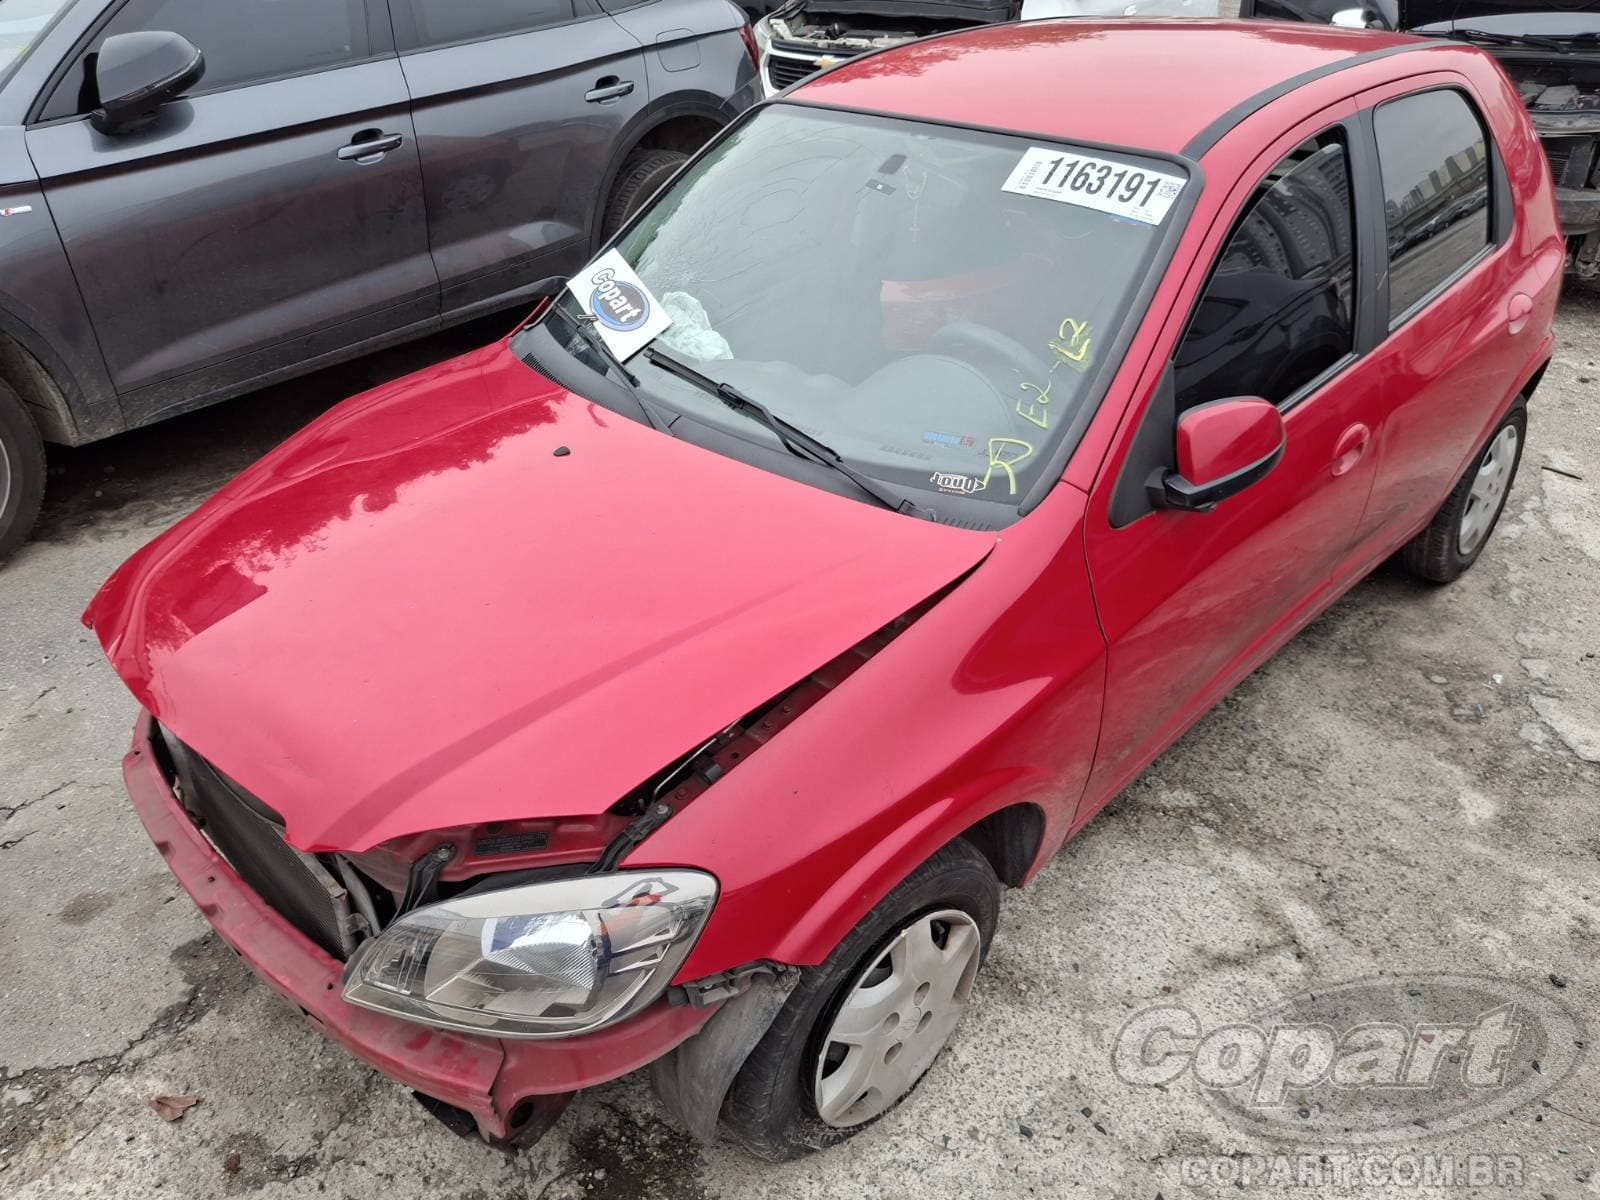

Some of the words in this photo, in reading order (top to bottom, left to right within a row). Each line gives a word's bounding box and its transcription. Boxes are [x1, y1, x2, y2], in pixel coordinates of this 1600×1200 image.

[1042, 156, 1161, 207] 1163191
[592, 267, 642, 323] Copart
[983, 437, 1033, 495] R
